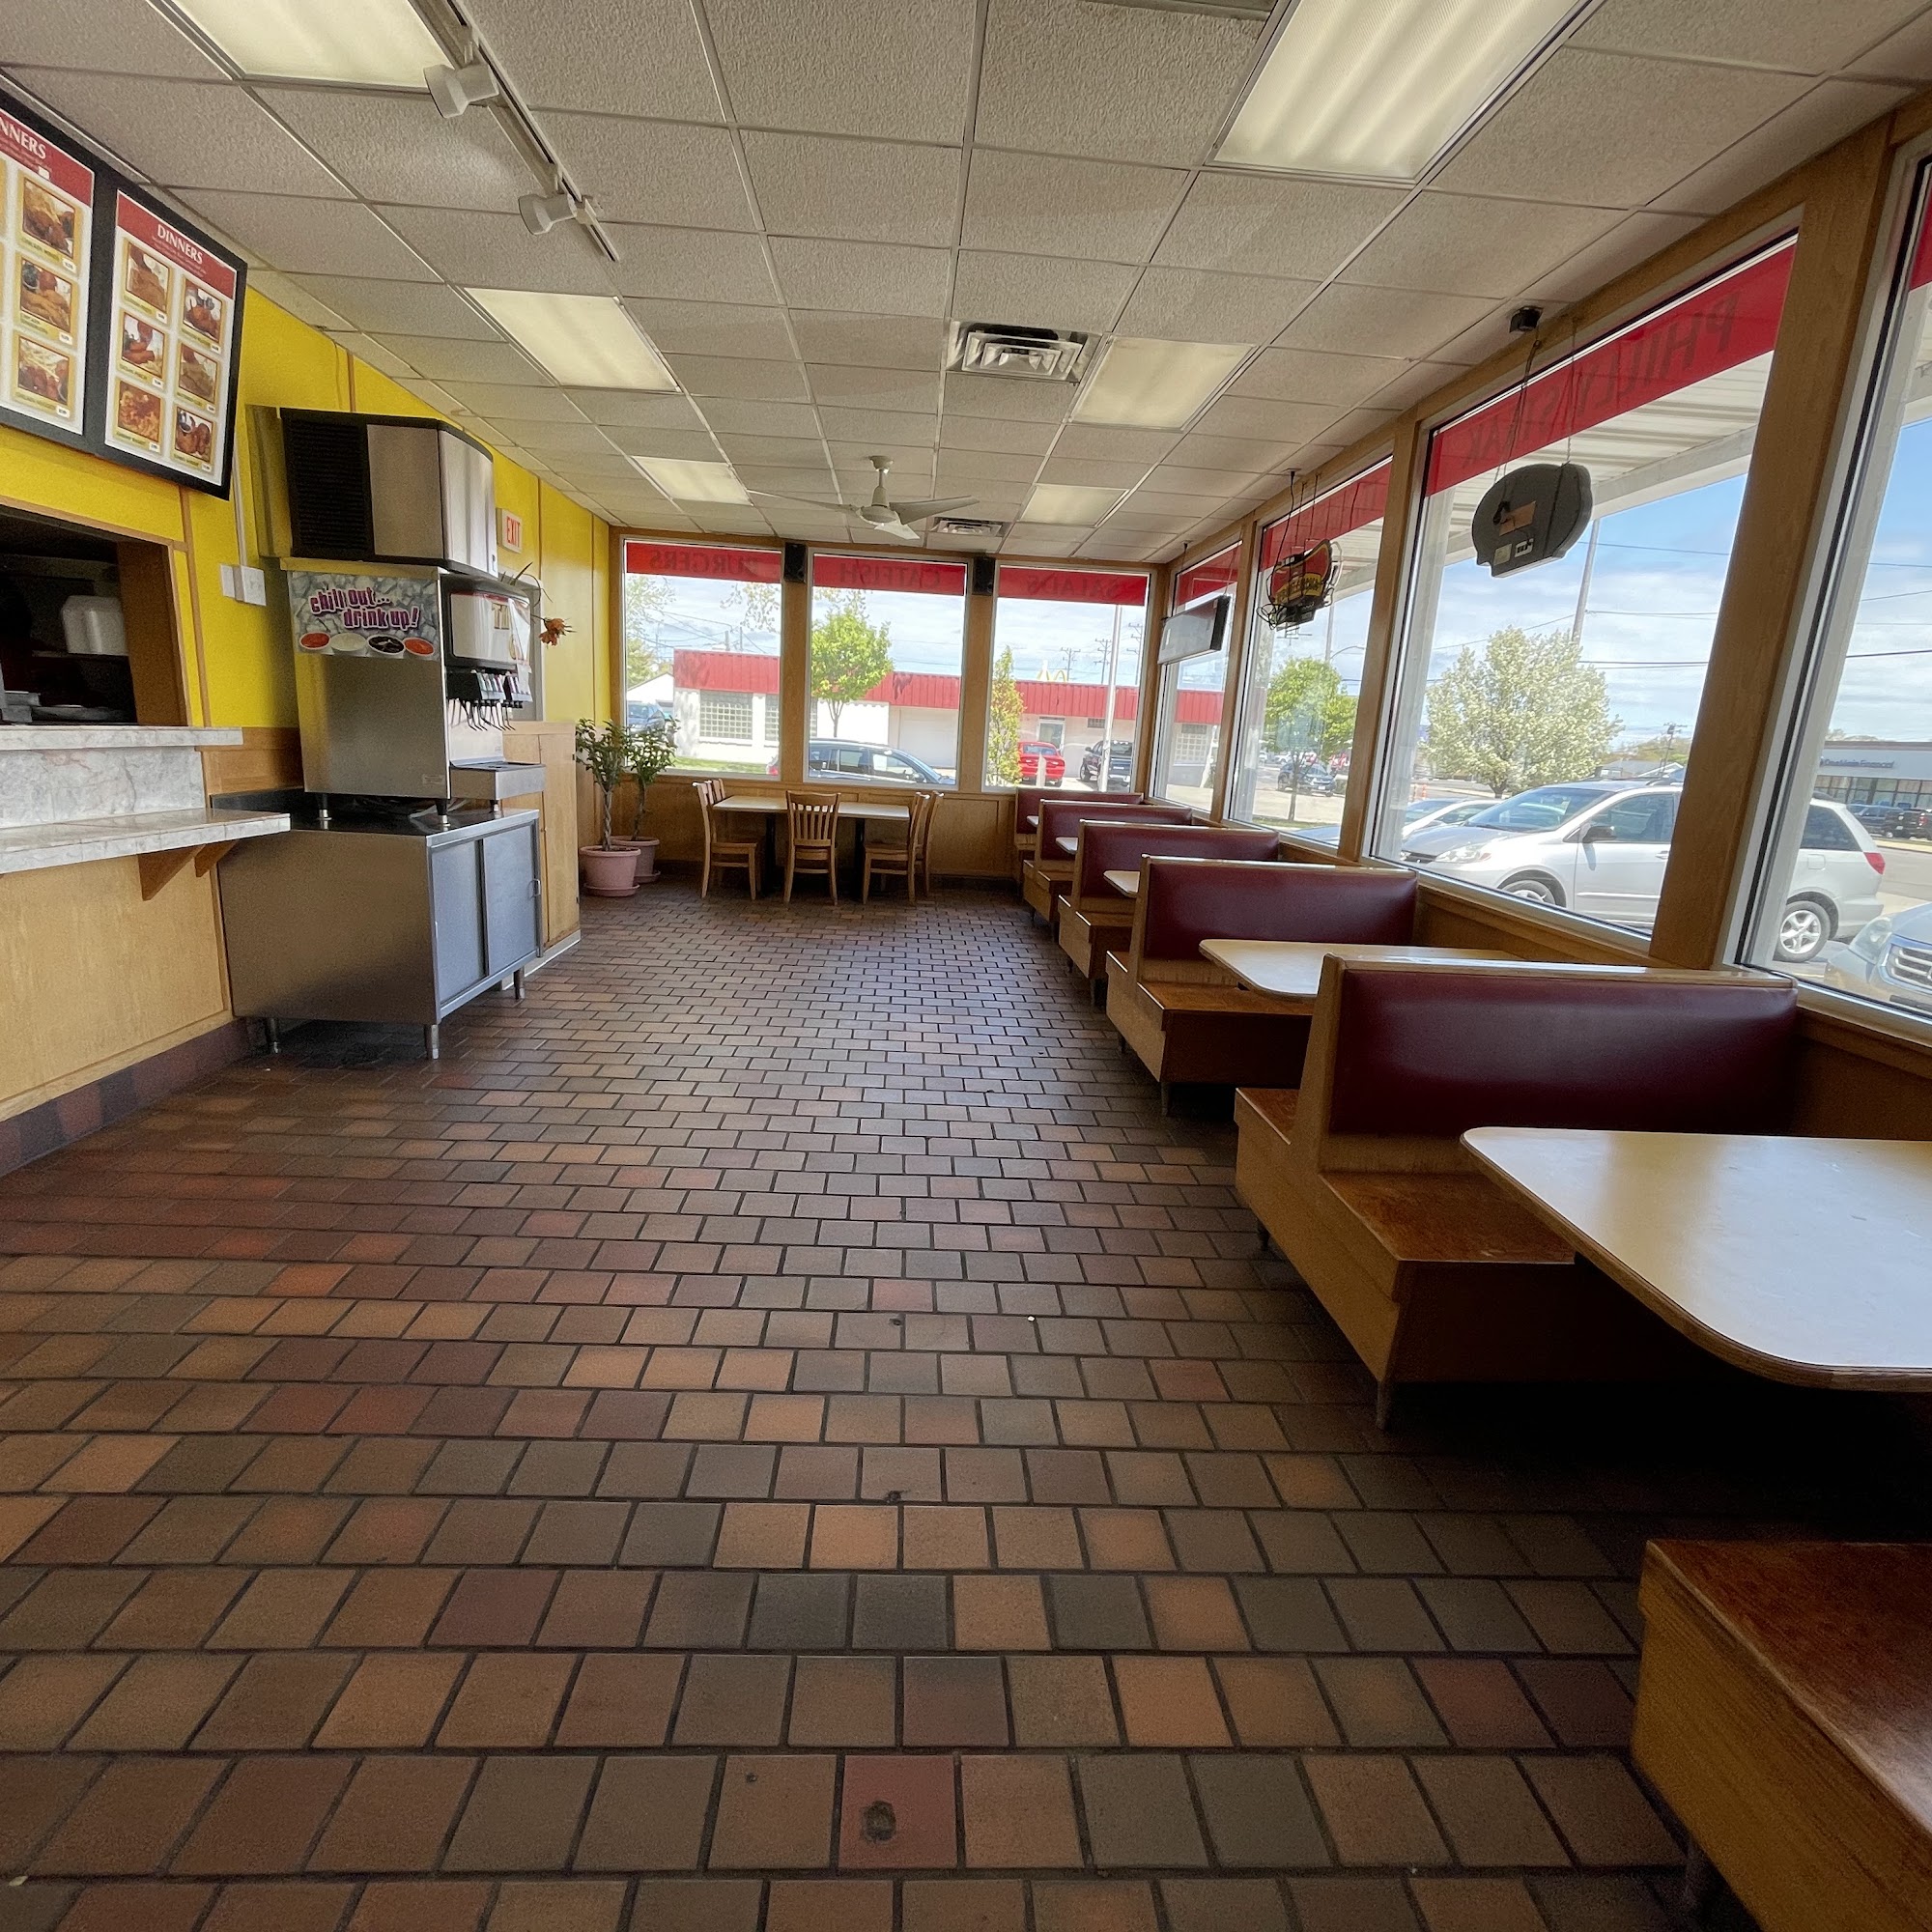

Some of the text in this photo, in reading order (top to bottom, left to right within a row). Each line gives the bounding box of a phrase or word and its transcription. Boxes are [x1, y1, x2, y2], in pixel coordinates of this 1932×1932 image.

[157, 223, 203, 265] DINNERS
[506, 515, 521, 548] EXIT
[310, 588, 347, 613] chill
[343, 607, 419, 631] drink up!
